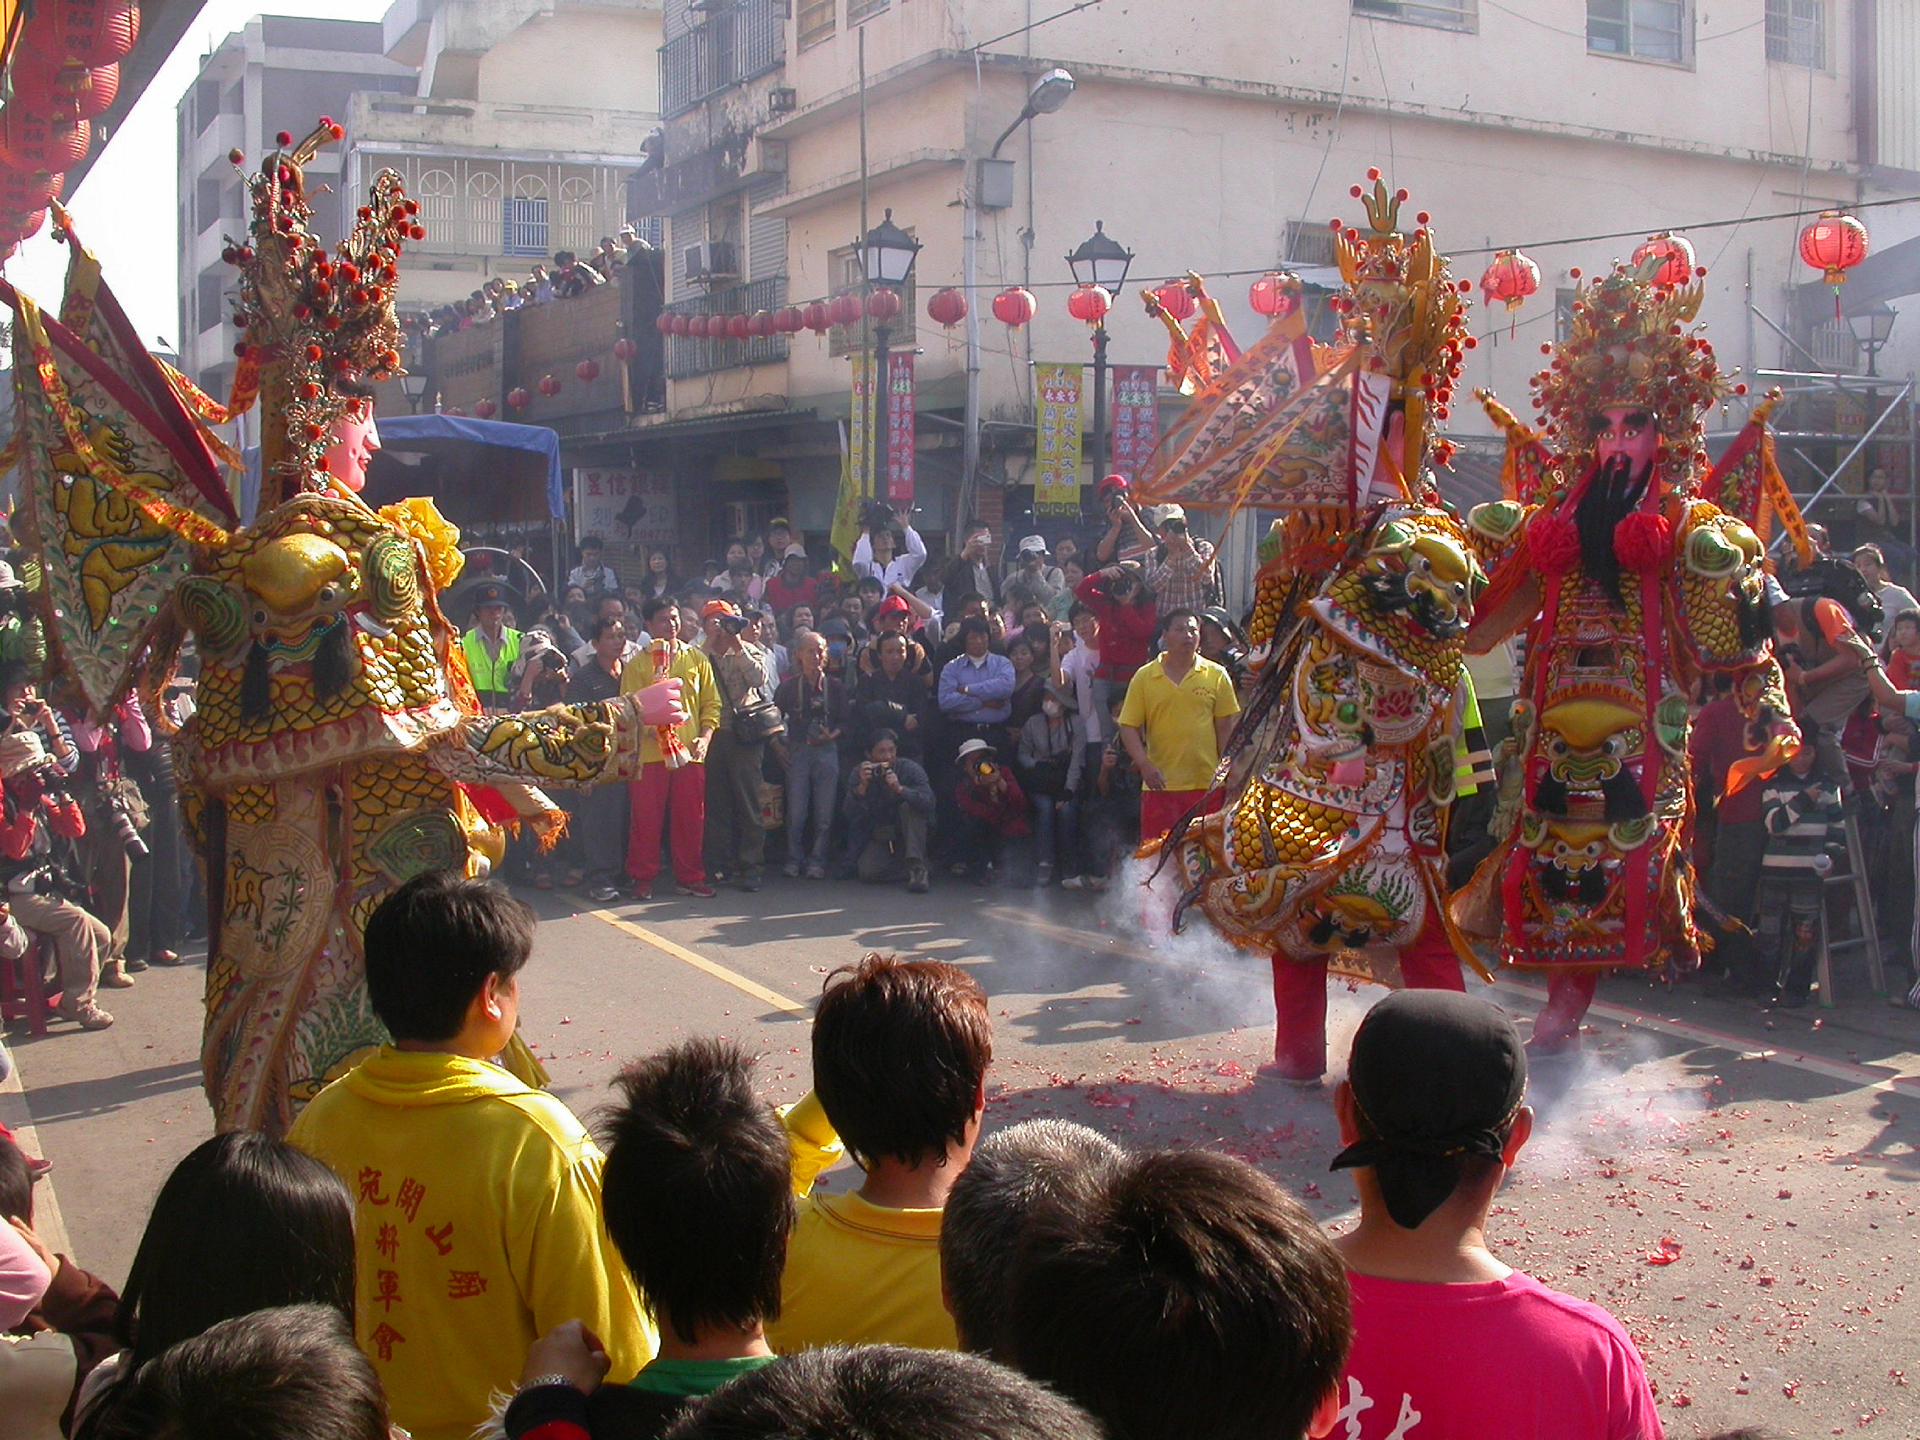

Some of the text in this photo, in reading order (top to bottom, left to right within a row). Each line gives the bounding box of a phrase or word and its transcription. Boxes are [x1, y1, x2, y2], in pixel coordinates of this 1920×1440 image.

[1045, 389, 1077, 404] 永安宮
[1041, 405, 1056, 487] 蘭陽第一宮
